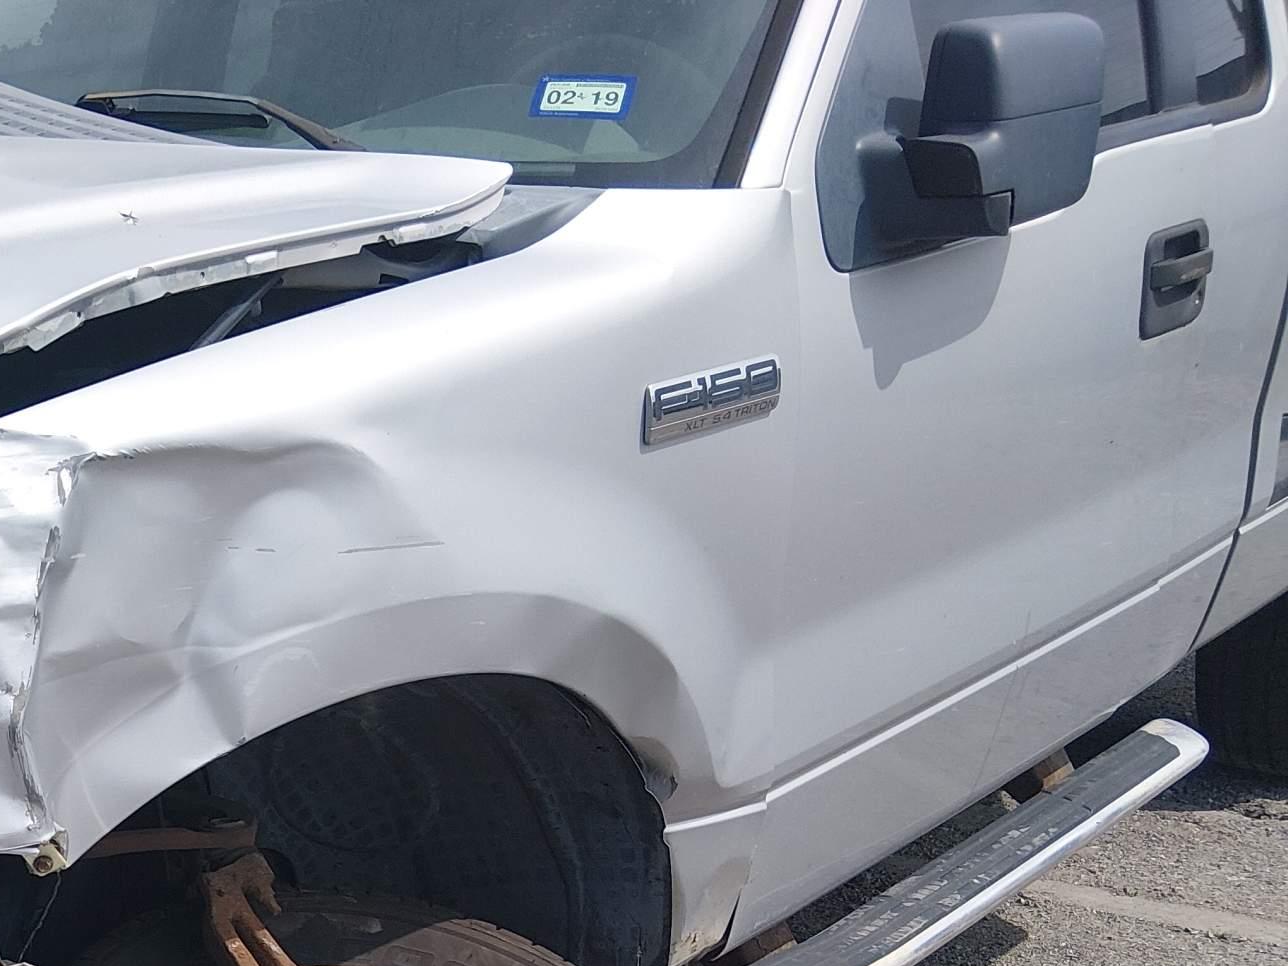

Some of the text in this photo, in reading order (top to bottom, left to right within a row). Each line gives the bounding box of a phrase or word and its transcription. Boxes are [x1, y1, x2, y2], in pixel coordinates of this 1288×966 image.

[547, 89, 619, 106] 02 19
[684, 418, 706, 432] XLT
[735, 399, 776, 419] TRITON
